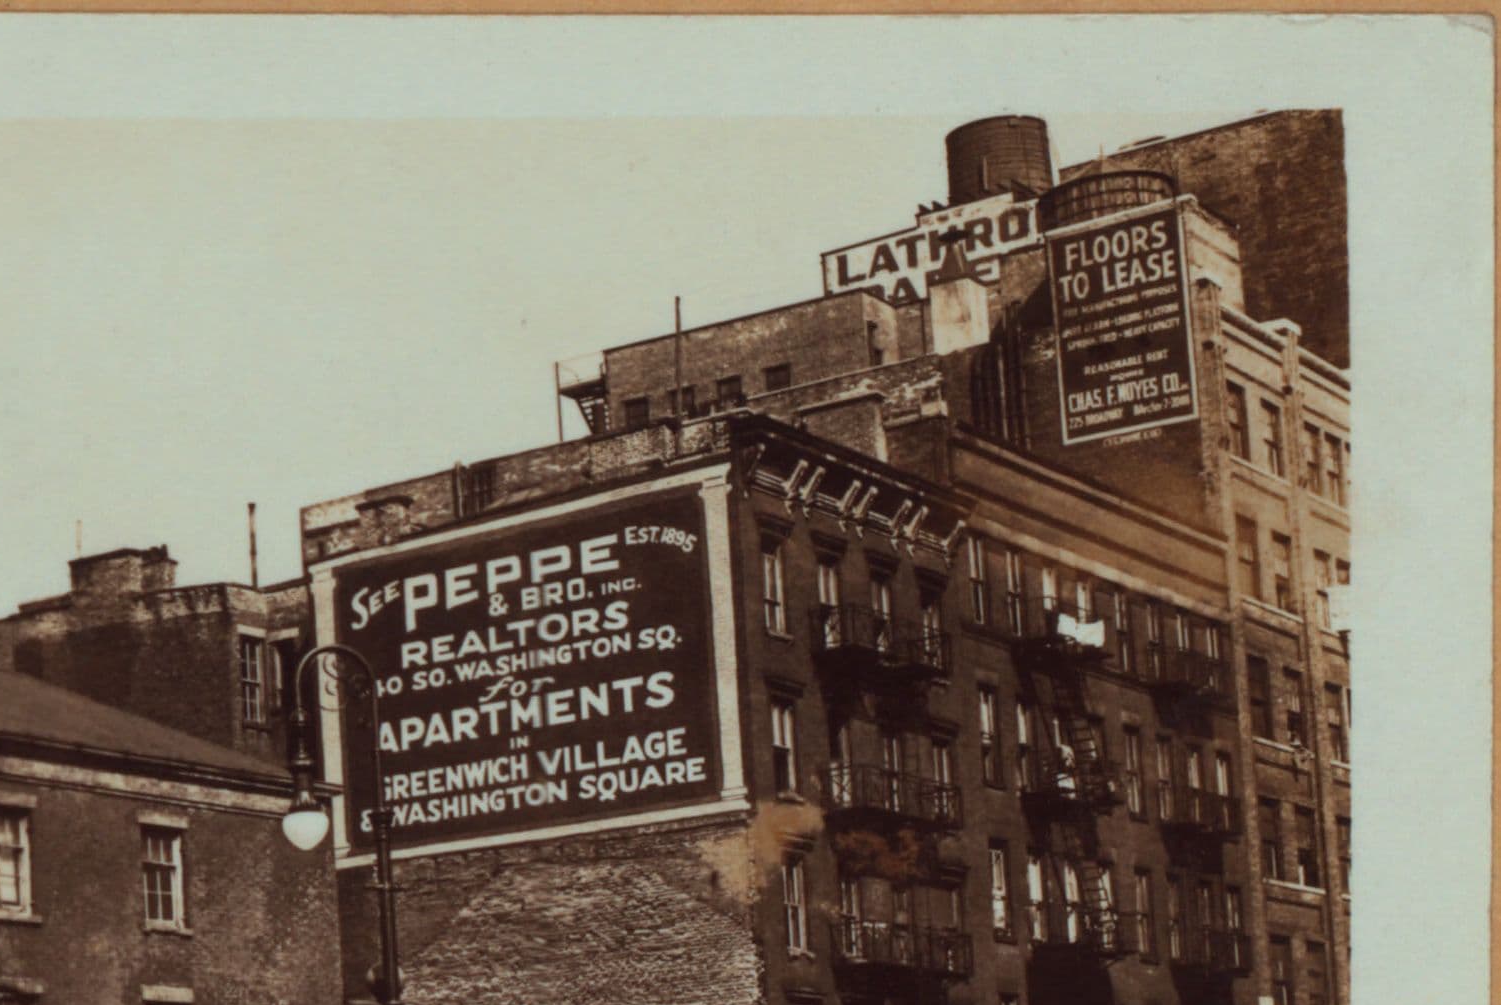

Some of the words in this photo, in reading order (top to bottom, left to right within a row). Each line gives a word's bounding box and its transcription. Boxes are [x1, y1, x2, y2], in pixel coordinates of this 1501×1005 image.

[1065, 220, 1167, 271] FLOORS
[1059, 272, 1090, 302] TO
[1102, 250, 1177, 293] LEASE
[1117, 376, 1159, 404] NOYES
[403, 533, 620, 633] PEPPE
[488, 592, 509, 617] &
[521, 577, 593, 611] BRO.
[601, 577, 642, 595] INC.
[401, 600, 629, 669] REALTORS
[412, 667, 453, 690] SO.
[454, 632, 632, 682] WASHINGTON
[637, 624, 682, 650] SQ.
[379, 671, 675, 752] APARTMENTS
[510, 735, 530, 749] IN
[537, 727, 687, 776] VILLAGE
[391, 778, 568, 827] WASHINGTON
[578, 757, 706, 802] SQUARE
